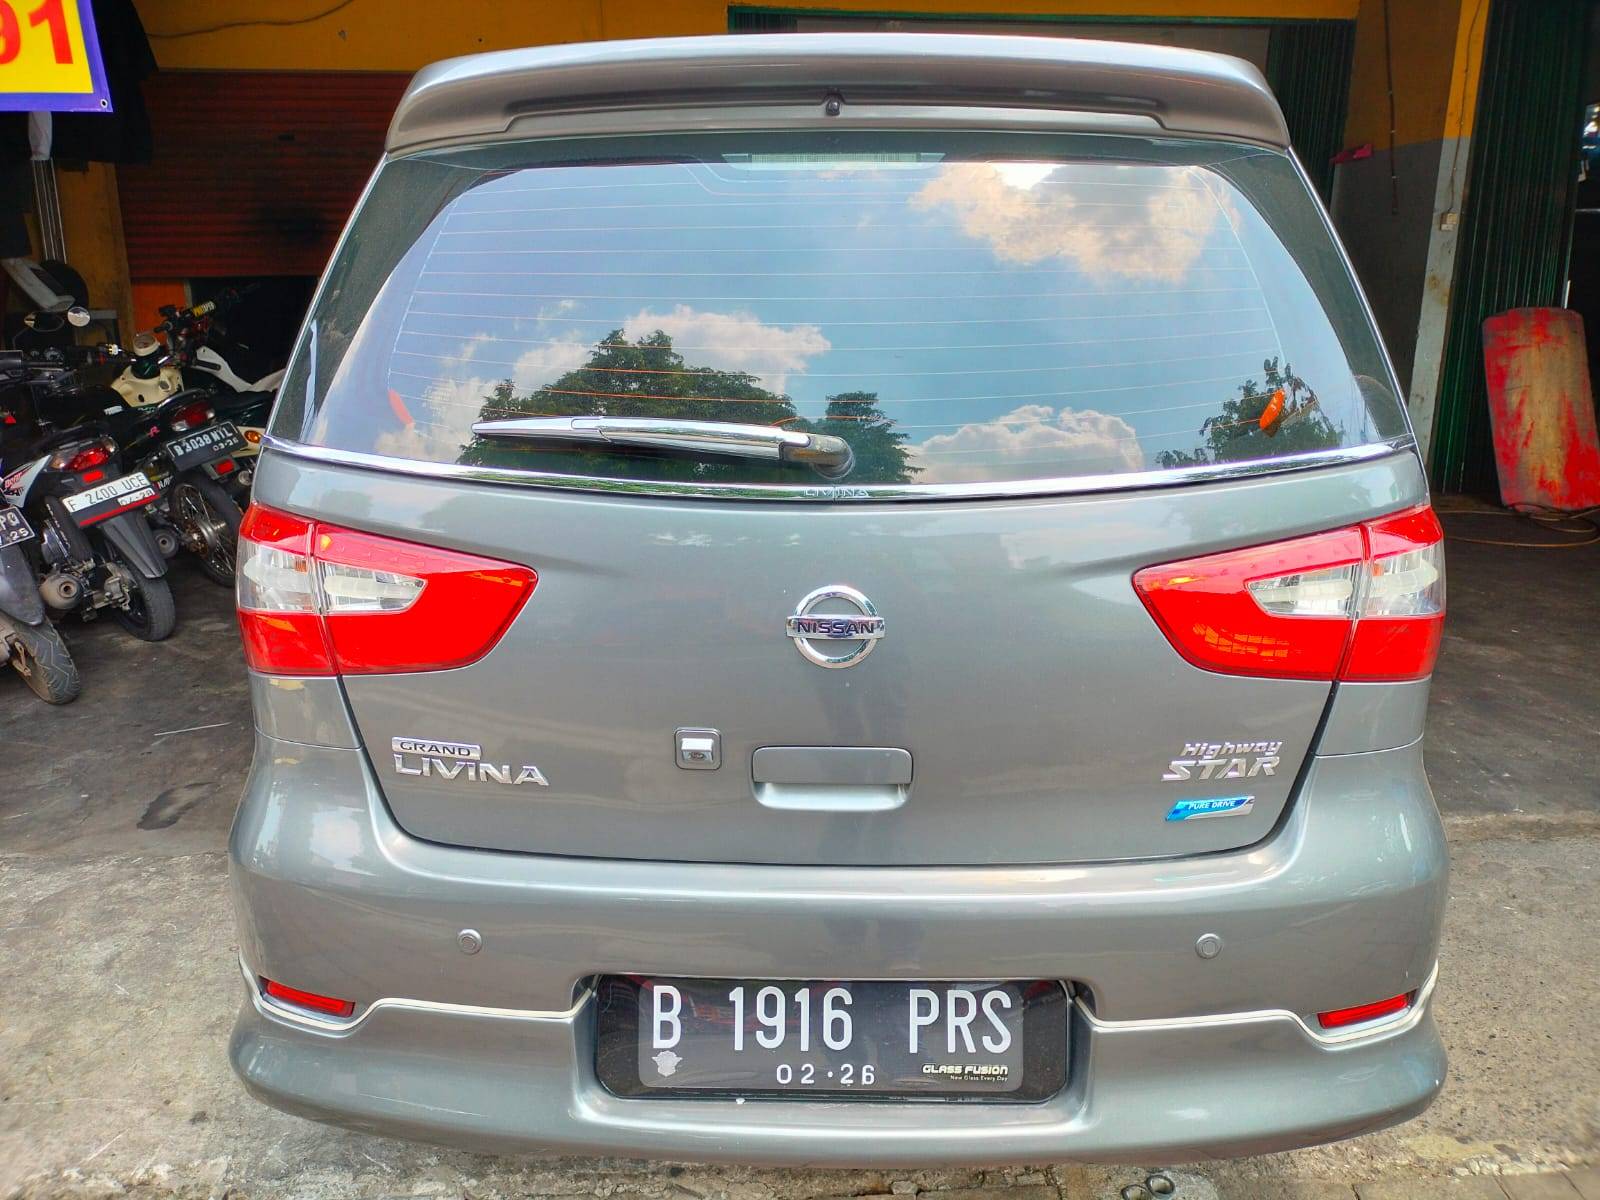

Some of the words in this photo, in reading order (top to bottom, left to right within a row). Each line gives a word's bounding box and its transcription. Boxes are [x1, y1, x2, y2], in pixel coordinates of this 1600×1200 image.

[173, 444, 185, 456] B
[68, 499, 77, 511] F
[85, 485, 118, 504] 2400
[121, 475, 148, 490] UCE
[797, 620, 875, 634] NISSAN
[400, 741, 471, 757] GRAND
[1180, 741, 1283, 760] Highway
[393, 753, 549, 786] LIVINA
[1161, 756, 1280, 781] STAR
[1188, 801, 1209, 810] PURE
[1211, 800, 1236, 809] DRIVE
[653, 985, 682, 1049] B
[729, 986, 853, 1052] 1916
[909, 989, 1011, 1053] PRS
[922, 1065, 962, 1074] GLASS
